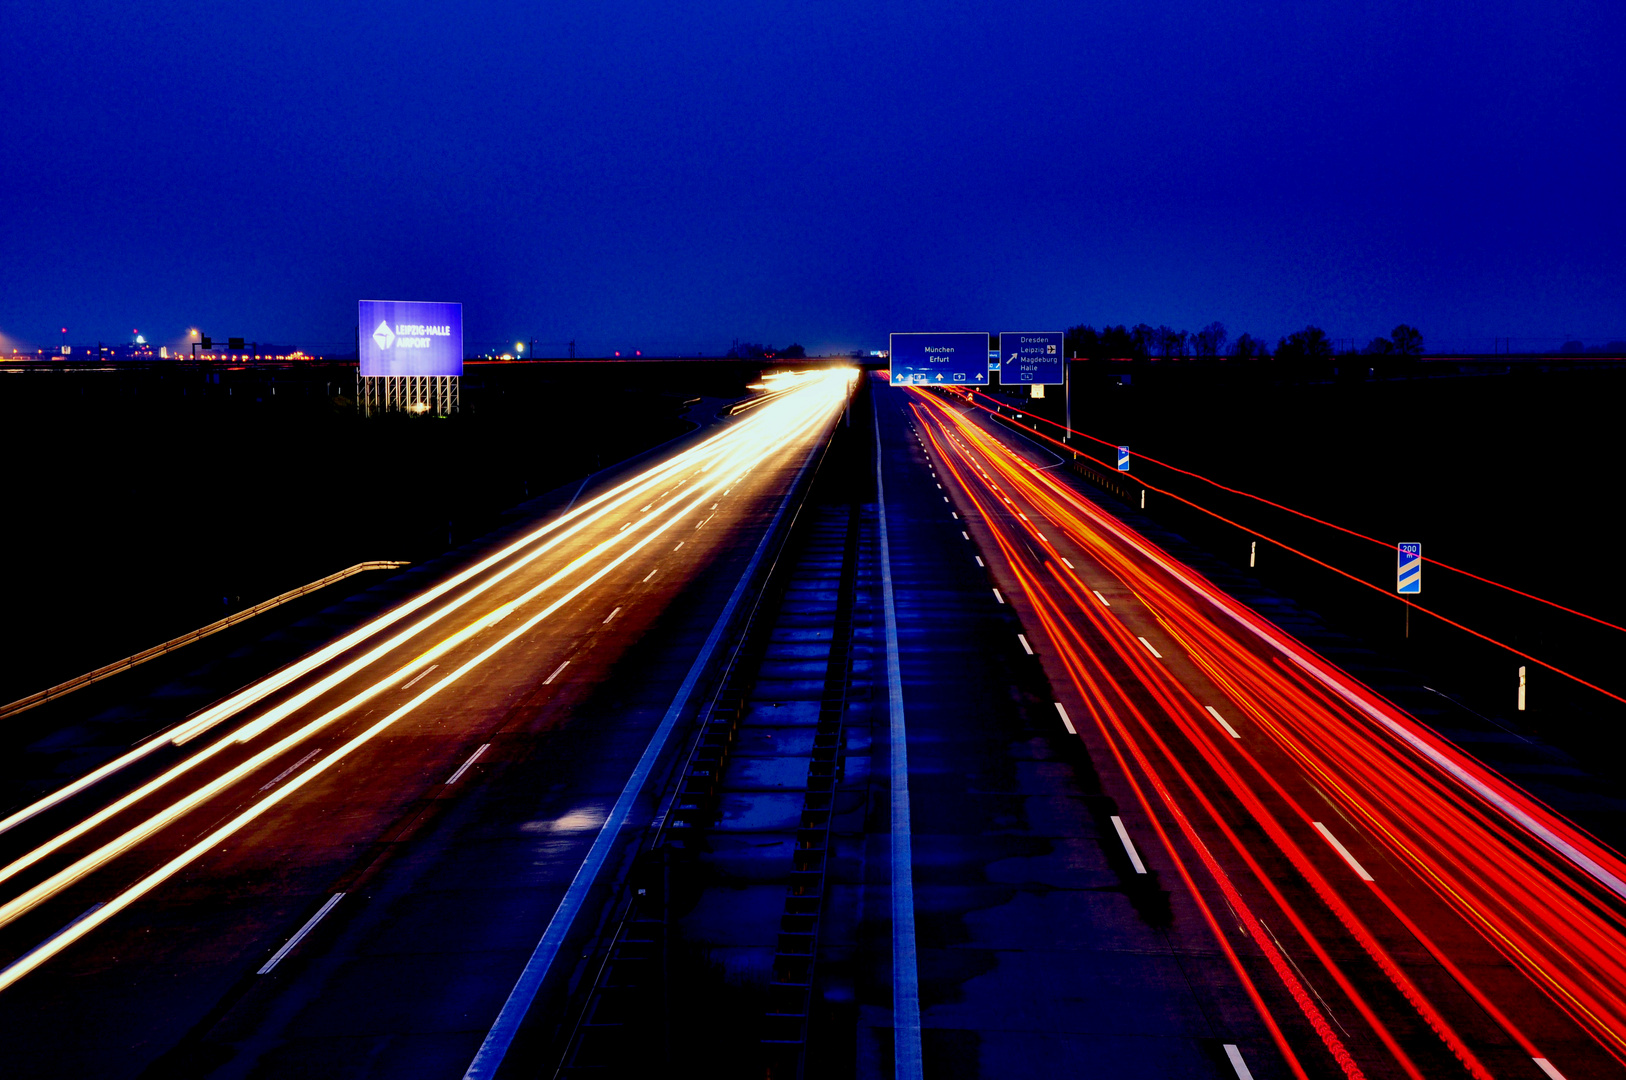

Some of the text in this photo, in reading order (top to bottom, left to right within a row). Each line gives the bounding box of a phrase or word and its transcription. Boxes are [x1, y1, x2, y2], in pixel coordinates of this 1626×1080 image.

[396, 325, 450, 336] LEIPZIG-HALLE
[397, 337, 431, 348] AIRPORT
[1403, 545, 1417, 553] 200
